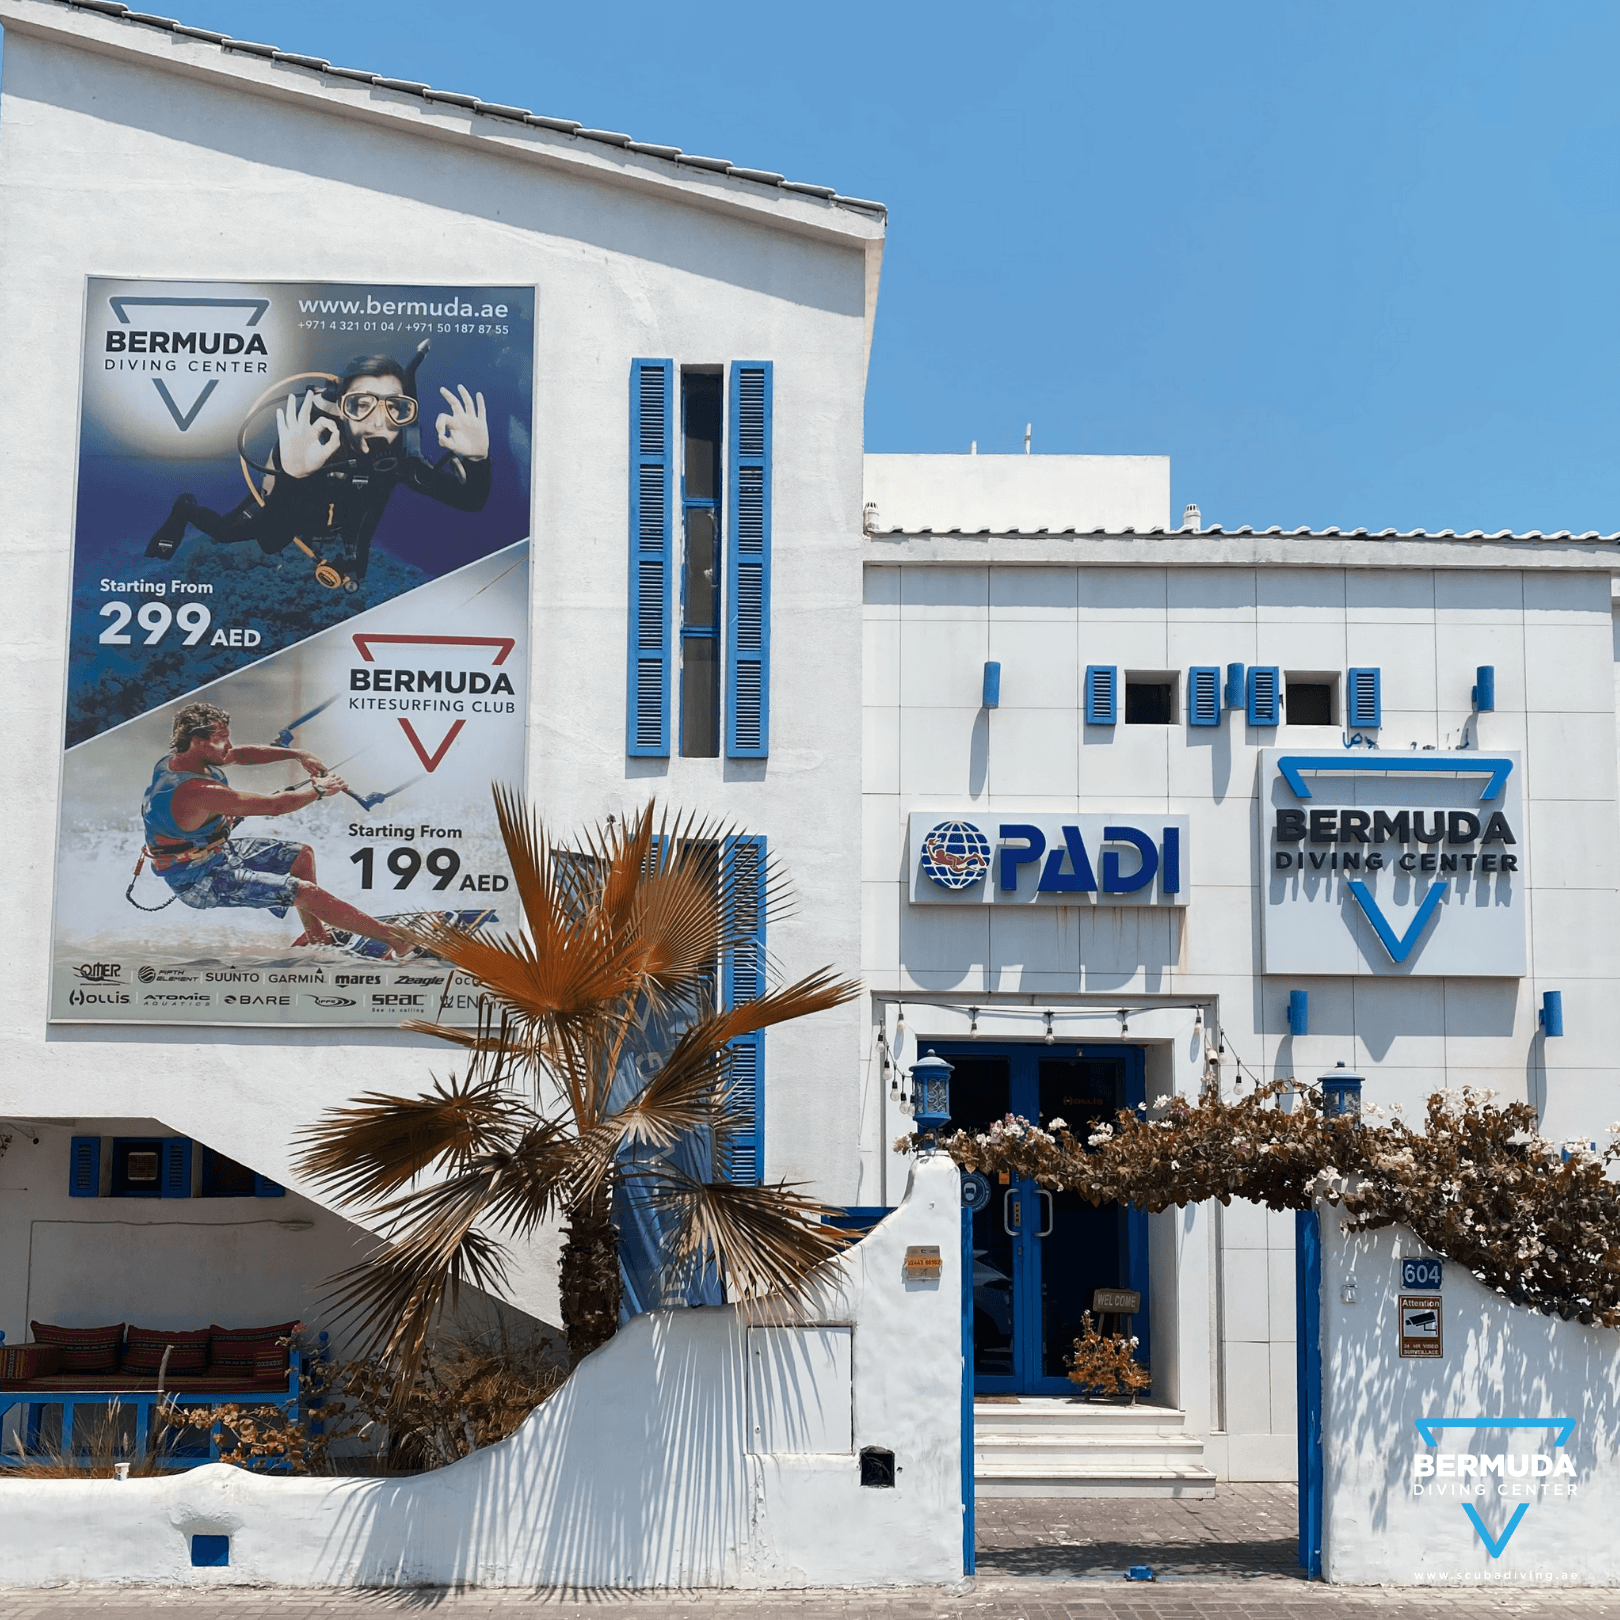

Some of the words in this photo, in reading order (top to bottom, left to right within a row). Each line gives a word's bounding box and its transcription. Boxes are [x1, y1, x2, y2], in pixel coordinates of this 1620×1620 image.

[298, 295, 508, 317] www.bermuda.ae
[298, 320, 326, 330] +971
[329, 321, 336, 330] 4
[339, 321, 359, 331] 321
[364, 322, 377, 331] 01
[381, 322, 394, 331] 04
[405, 323, 433, 332] +971
[437, 323, 451, 333] 50
[455, 324, 475, 334] 187
[478, 325, 492, 334] 87
[495, 325, 509, 335] 55
[105, 331, 268, 355] BERMUDA
[105, 359, 176, 371] DIVING
[188, 361, 268, 373] CENTER
[100, 578, 166, 597] Starting
[171, 580, 213, 594] From
[99, 601, 211, 646] 299
[210, 629, 261, 647] AED
[350, 669, 516, 695] BERMUDA
[349, 698, 464, 712] KITESURFING
[472, 701, 515, 713] CLUB
[348, 823, 415, 841] Starting
[420, 825, 462, 838] From
[1276, 808, 1517, 845] BERMUDA
[999, 824, 1179, 894] PADI
[1275, 852, 1383, 870] DIVING
[1399, 853, 1519, 872] CENTER
[349, 847, 461, 891] 199
[459, 874, 509, 892] AED
[205, 972, 260, 983] SUUNTO
[268, 974, 325, 984] GARMIN
[335, 975, 381, 985] mares
[394, 975, 445, 987] Zeagle
[240, 995, 290, 1005] BARE
[1404, 1264, 1440, 1283] 604
[1097, 1294, 1136, 1308] WELCOME
[1402, 1299, 1440, 1307] Attention
